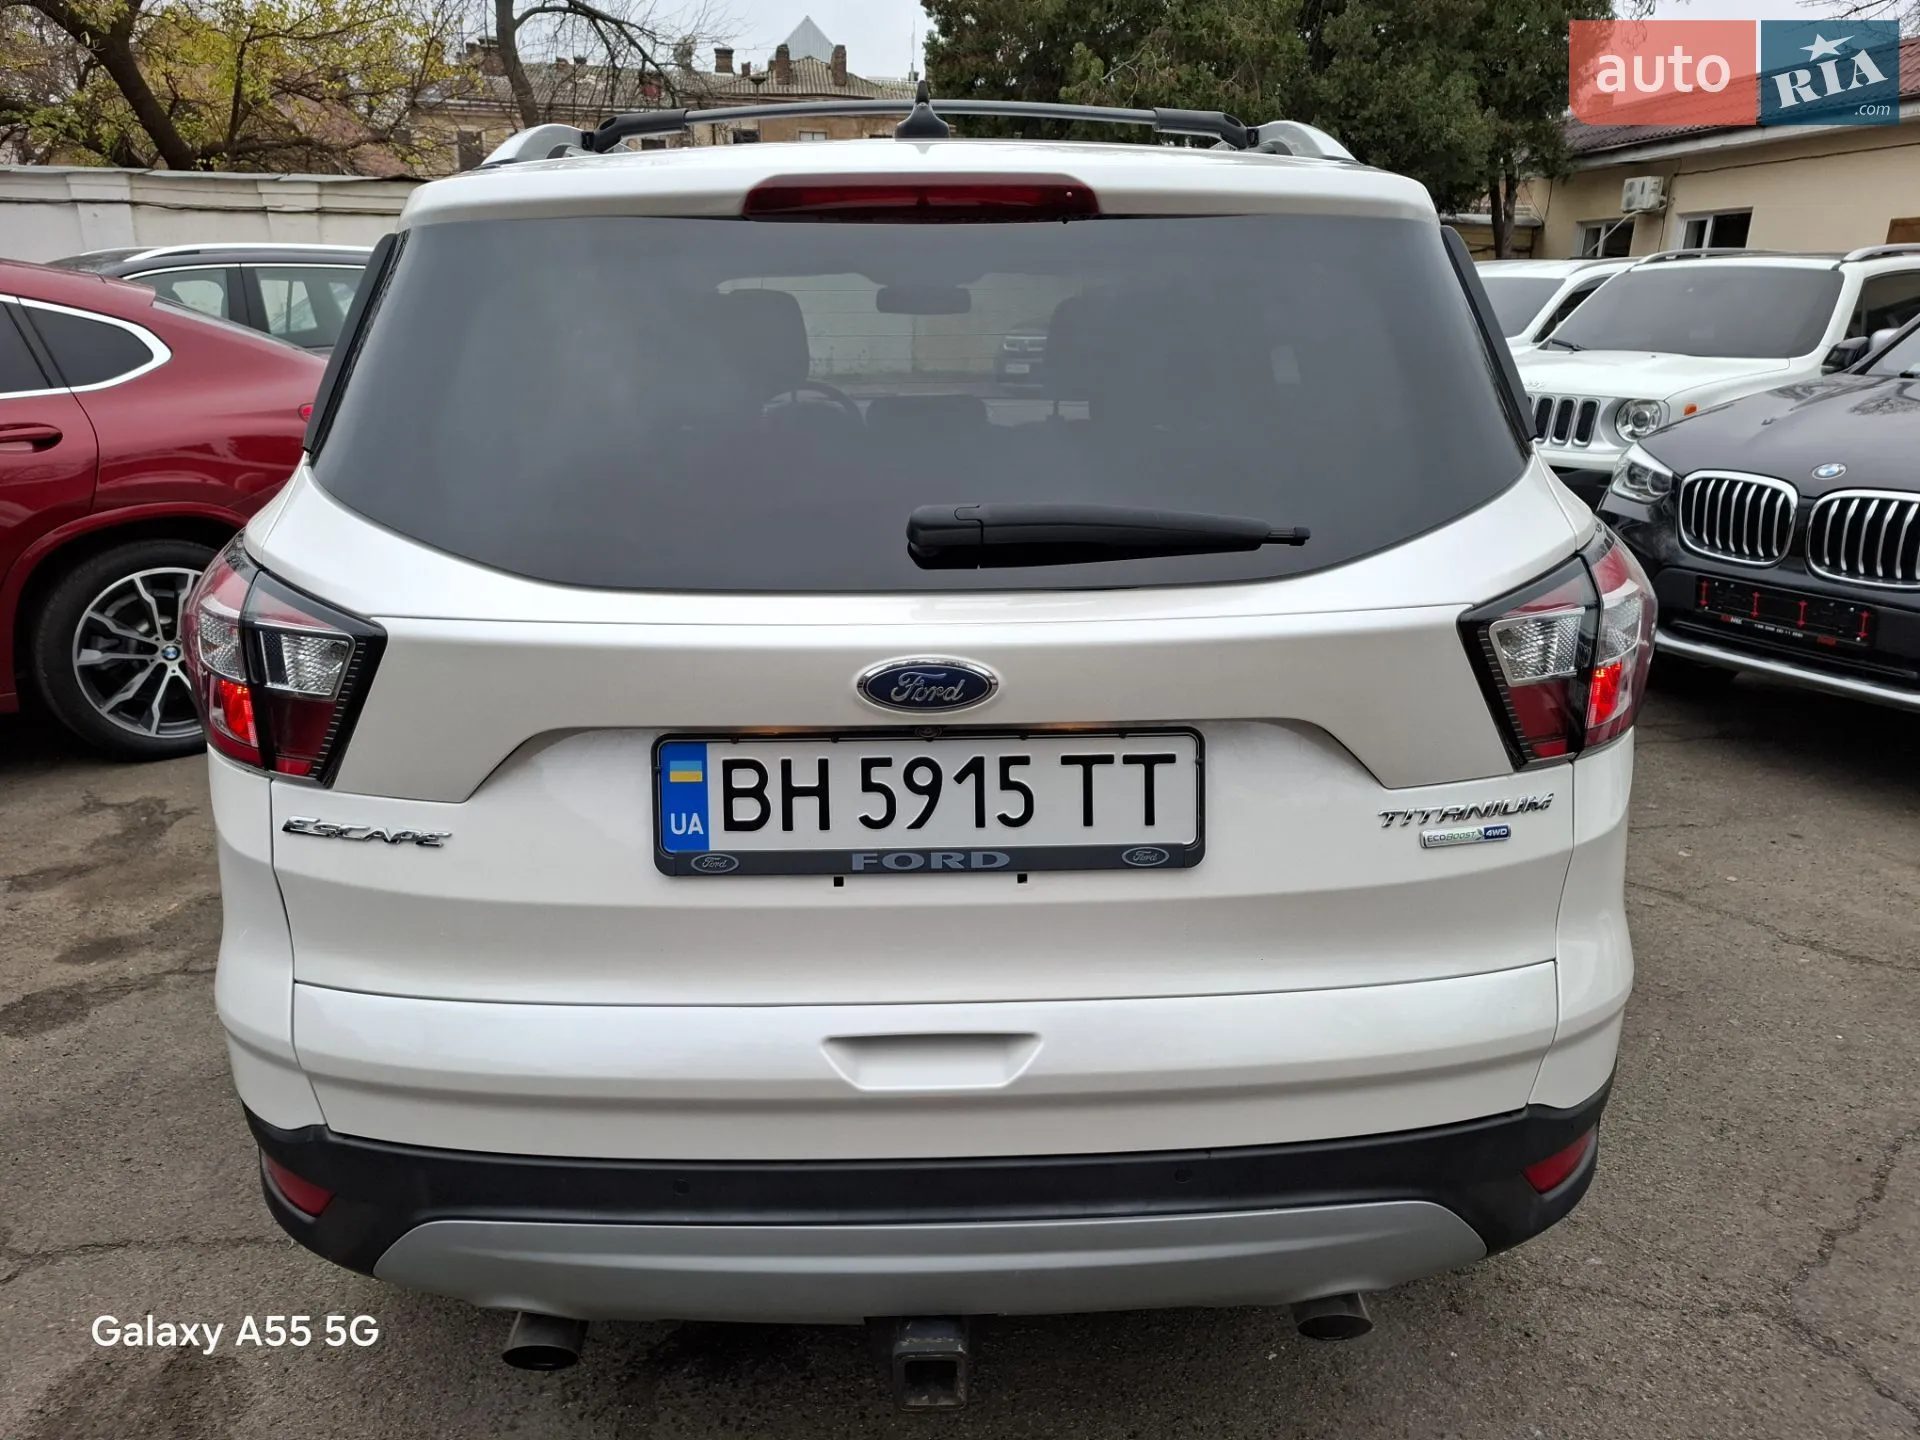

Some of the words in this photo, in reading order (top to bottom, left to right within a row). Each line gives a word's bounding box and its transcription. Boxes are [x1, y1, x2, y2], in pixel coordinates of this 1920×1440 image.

[891, 671, 966, 702] Ford
[722, 758, 831, 832] BH
[858, 755, 1035, 831] 5915
[1060, 753, 1177, 827] TT
[1378, 793, 1555, 828] TITANIUM
[670, 812, 704, 835] UA
[1486, 828, 1508, 837] 4WD
[702, 856, 728, 869] Ford
[852, 851, 1010, 871] FORD
[1132, 850, 1158, 863] Ford
